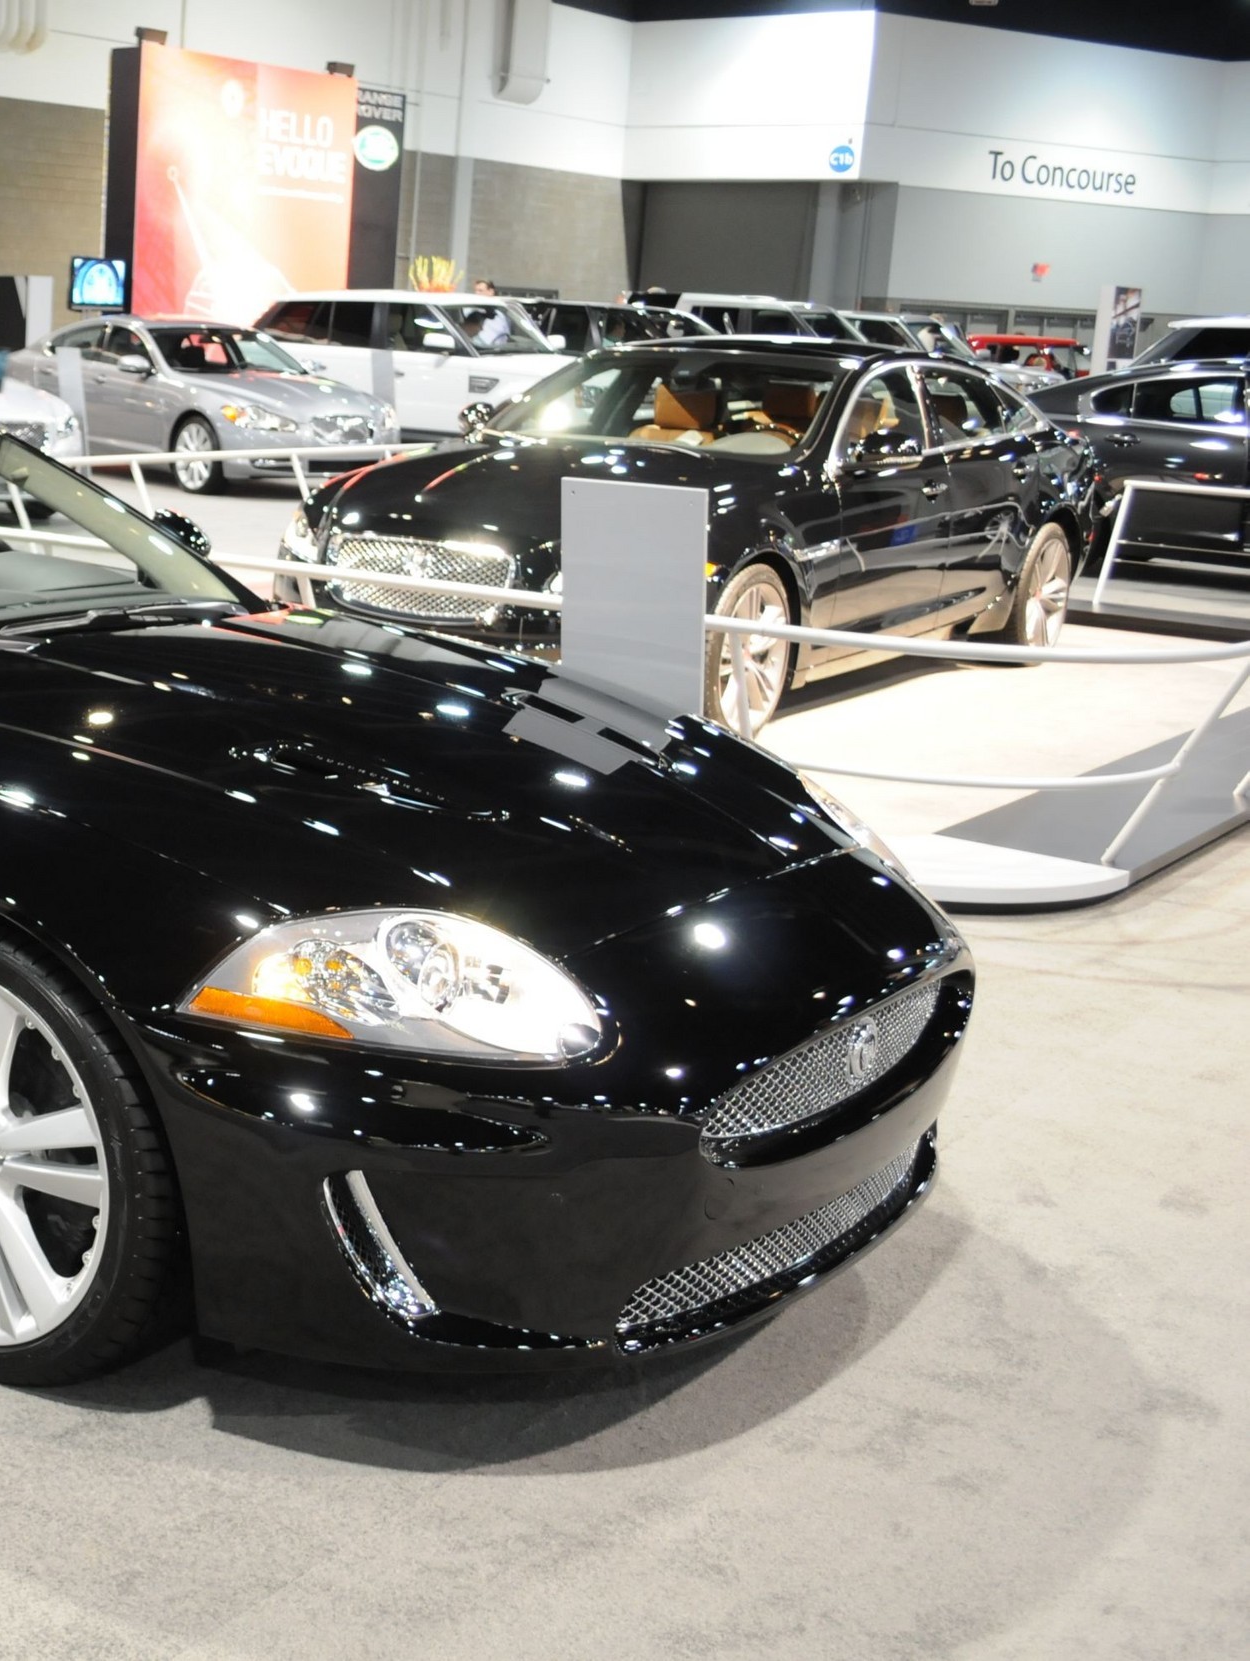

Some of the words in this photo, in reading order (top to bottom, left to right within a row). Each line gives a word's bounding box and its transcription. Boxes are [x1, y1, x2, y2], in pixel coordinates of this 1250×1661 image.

[258, 107, 334, 148] HELLO
[257, 143, 347, 184] EVOQUE
[988, 150, 1015, 181] To
[1021, 155, 1137, 195] Concourse
